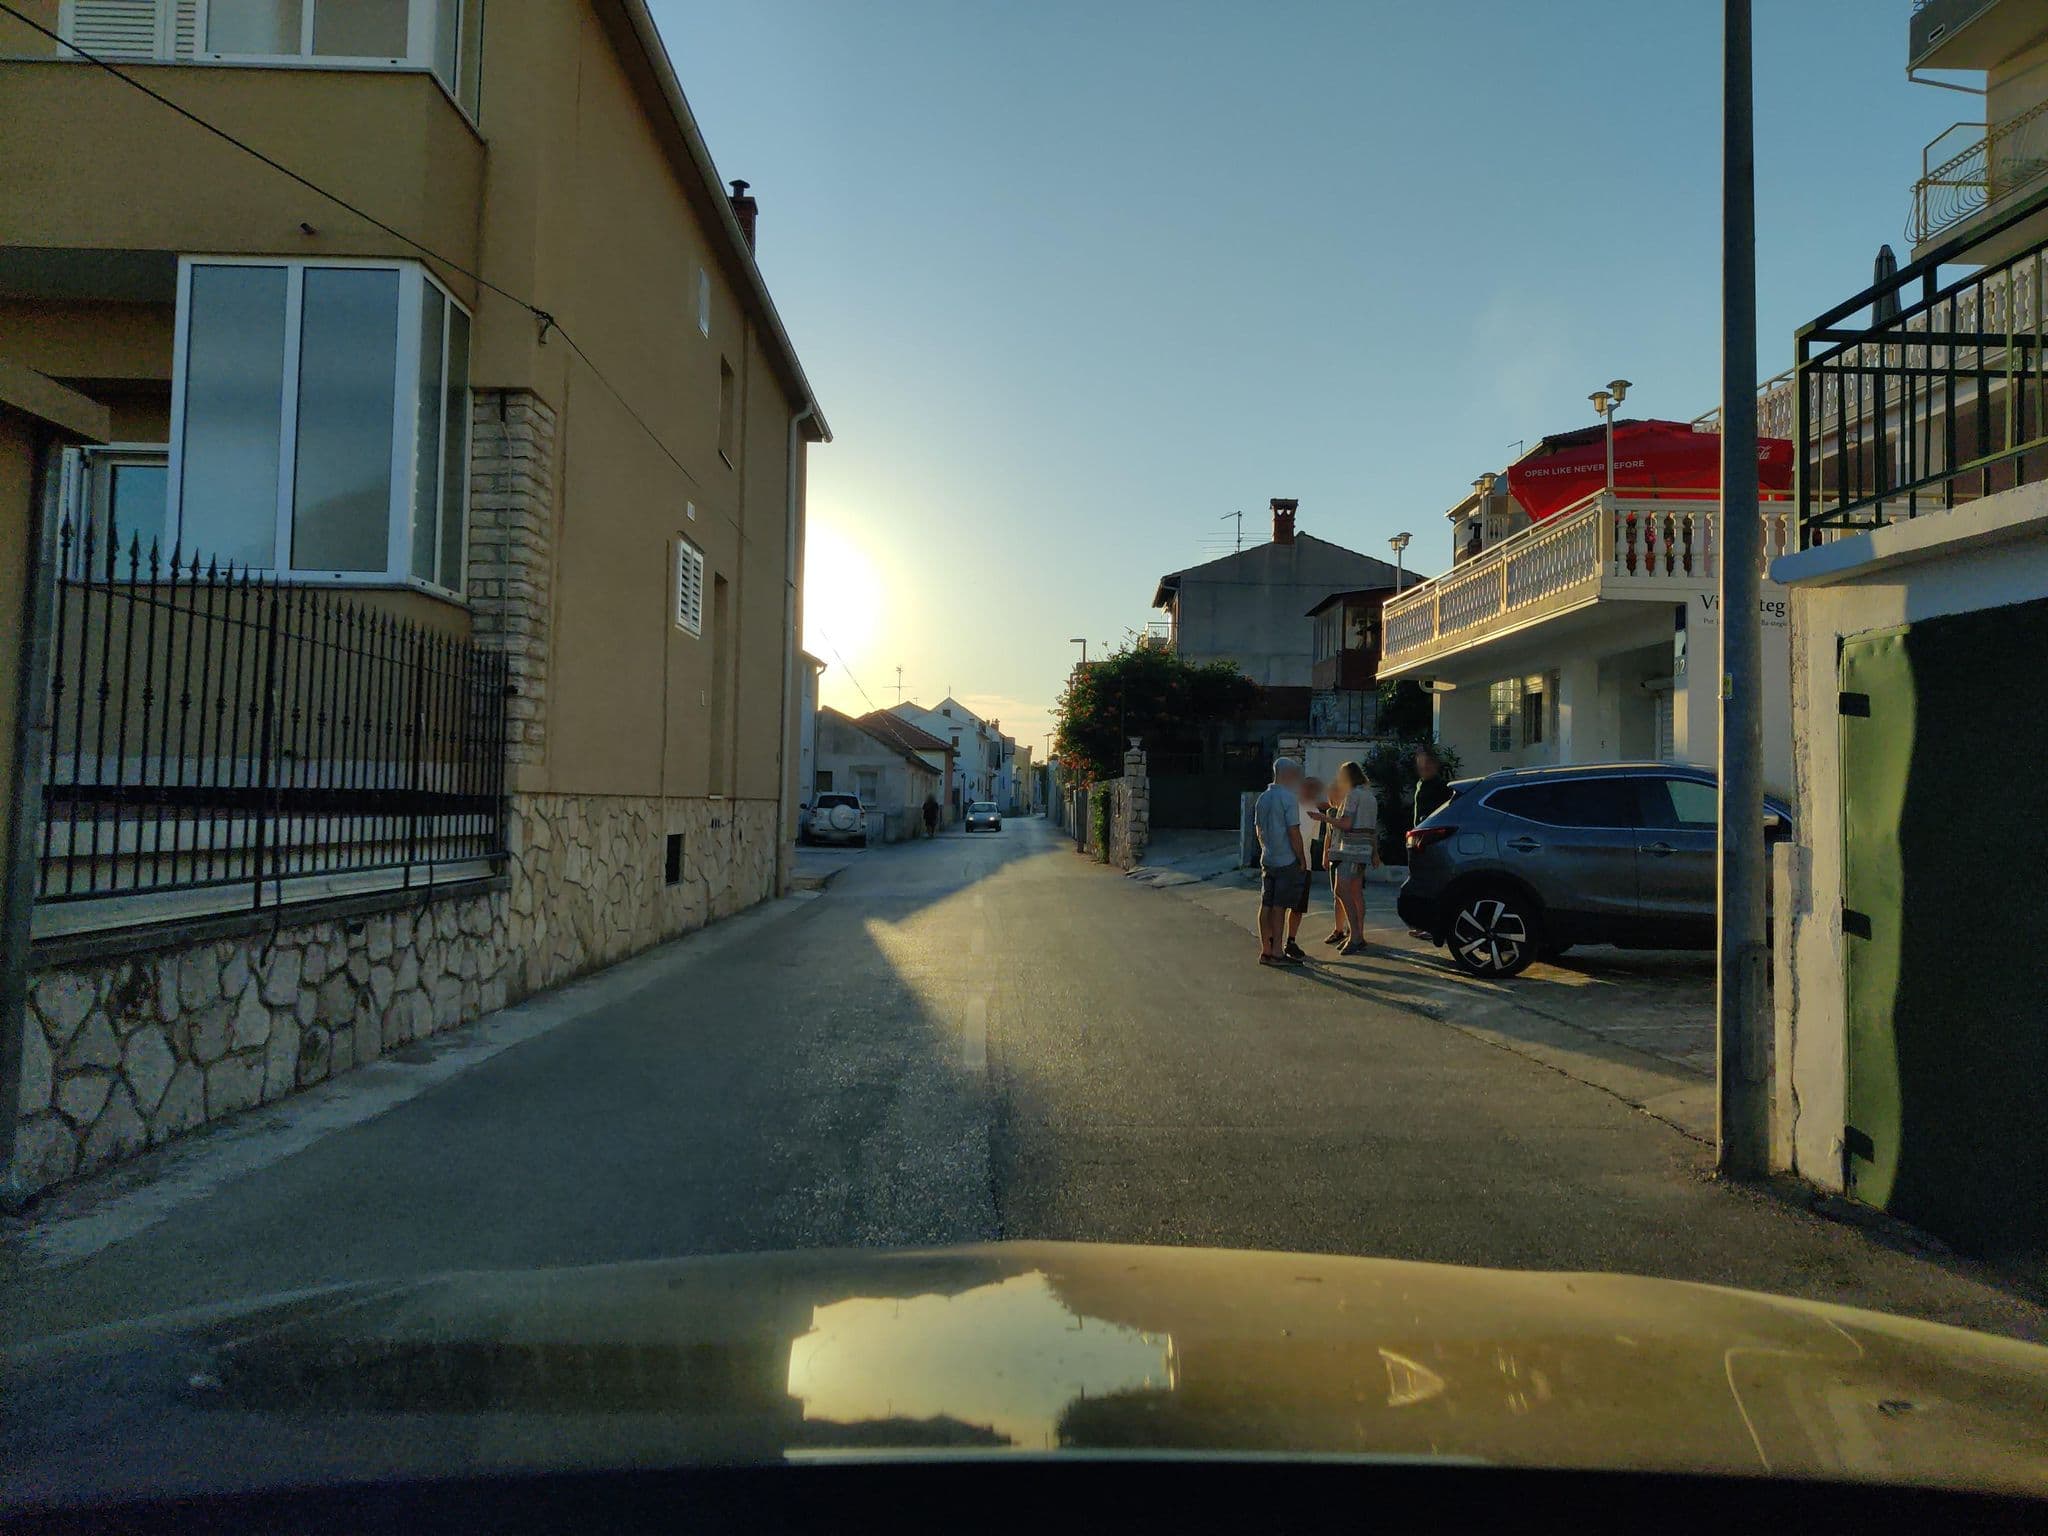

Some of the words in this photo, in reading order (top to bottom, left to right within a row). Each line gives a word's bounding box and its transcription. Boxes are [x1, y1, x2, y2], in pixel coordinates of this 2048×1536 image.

[1525, 468, 1550, 478] OPEN
[1552, 466, 1572, 475] LIKE
[1575, 463, 1605, 473] NEVER
[1613, 460, 1645, 470] EFORE
[1701, 595, 1719, 610] Vi
[1760, 600, 1786, 618] teg
